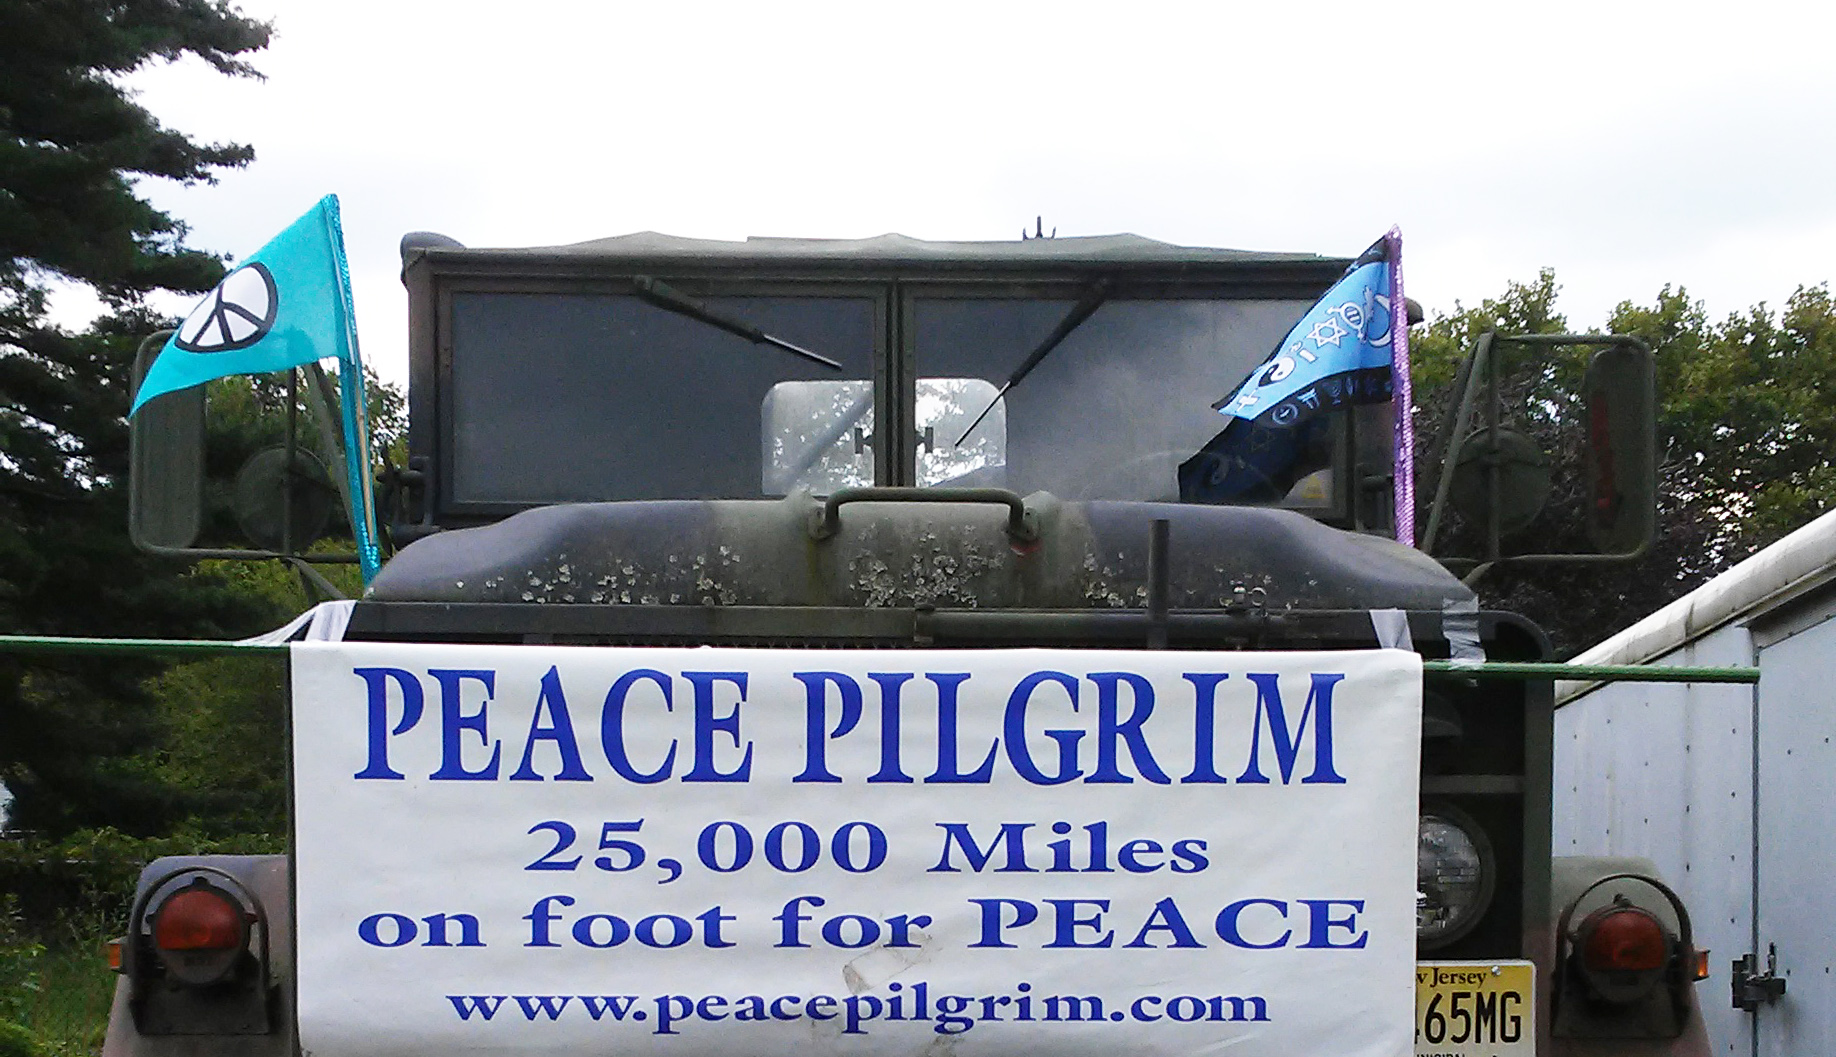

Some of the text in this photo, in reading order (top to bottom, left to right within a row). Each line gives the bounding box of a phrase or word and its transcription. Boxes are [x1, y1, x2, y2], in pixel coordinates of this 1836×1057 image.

[353, 665, 1348, 786] PEACE PILGRIM
[524, 818, 1211, 884] 25,000 Miles
[358, 895, 1370, 951] on foot for PEACE
[1430, 968, 1487, 988] Jersey
[445, 982, 1271, 1036] www.peacepilgrim.com
[1415, 991, 1521, 1044] 65MG
